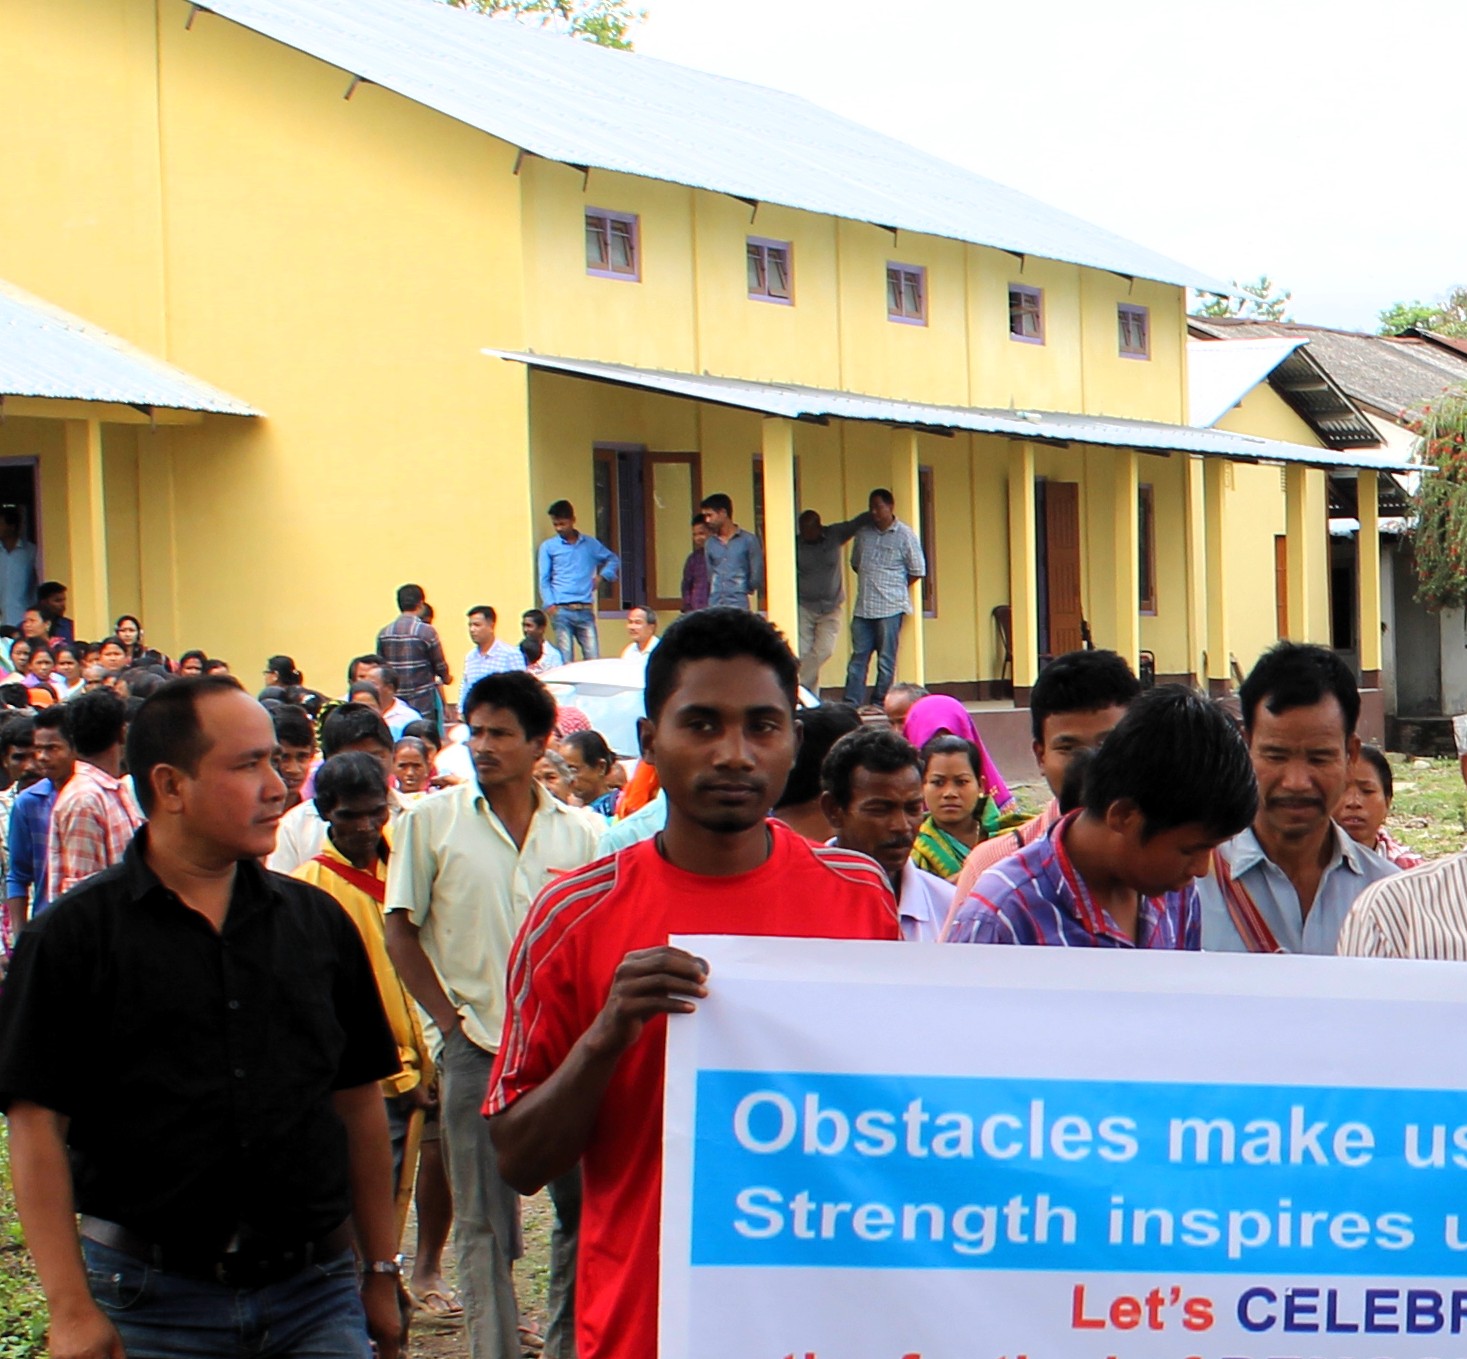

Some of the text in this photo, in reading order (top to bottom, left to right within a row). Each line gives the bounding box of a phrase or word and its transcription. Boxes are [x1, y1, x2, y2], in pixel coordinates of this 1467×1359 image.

[734, 1092, 1138, 1162] Obstacles
[1170, 1105, 1374, 1166] make
[735, 1187, 1076, 1255] Strength
[1110, 1194, 1414, 1259] inspires
[1073, 1285, 1214, 1331] Let’s
